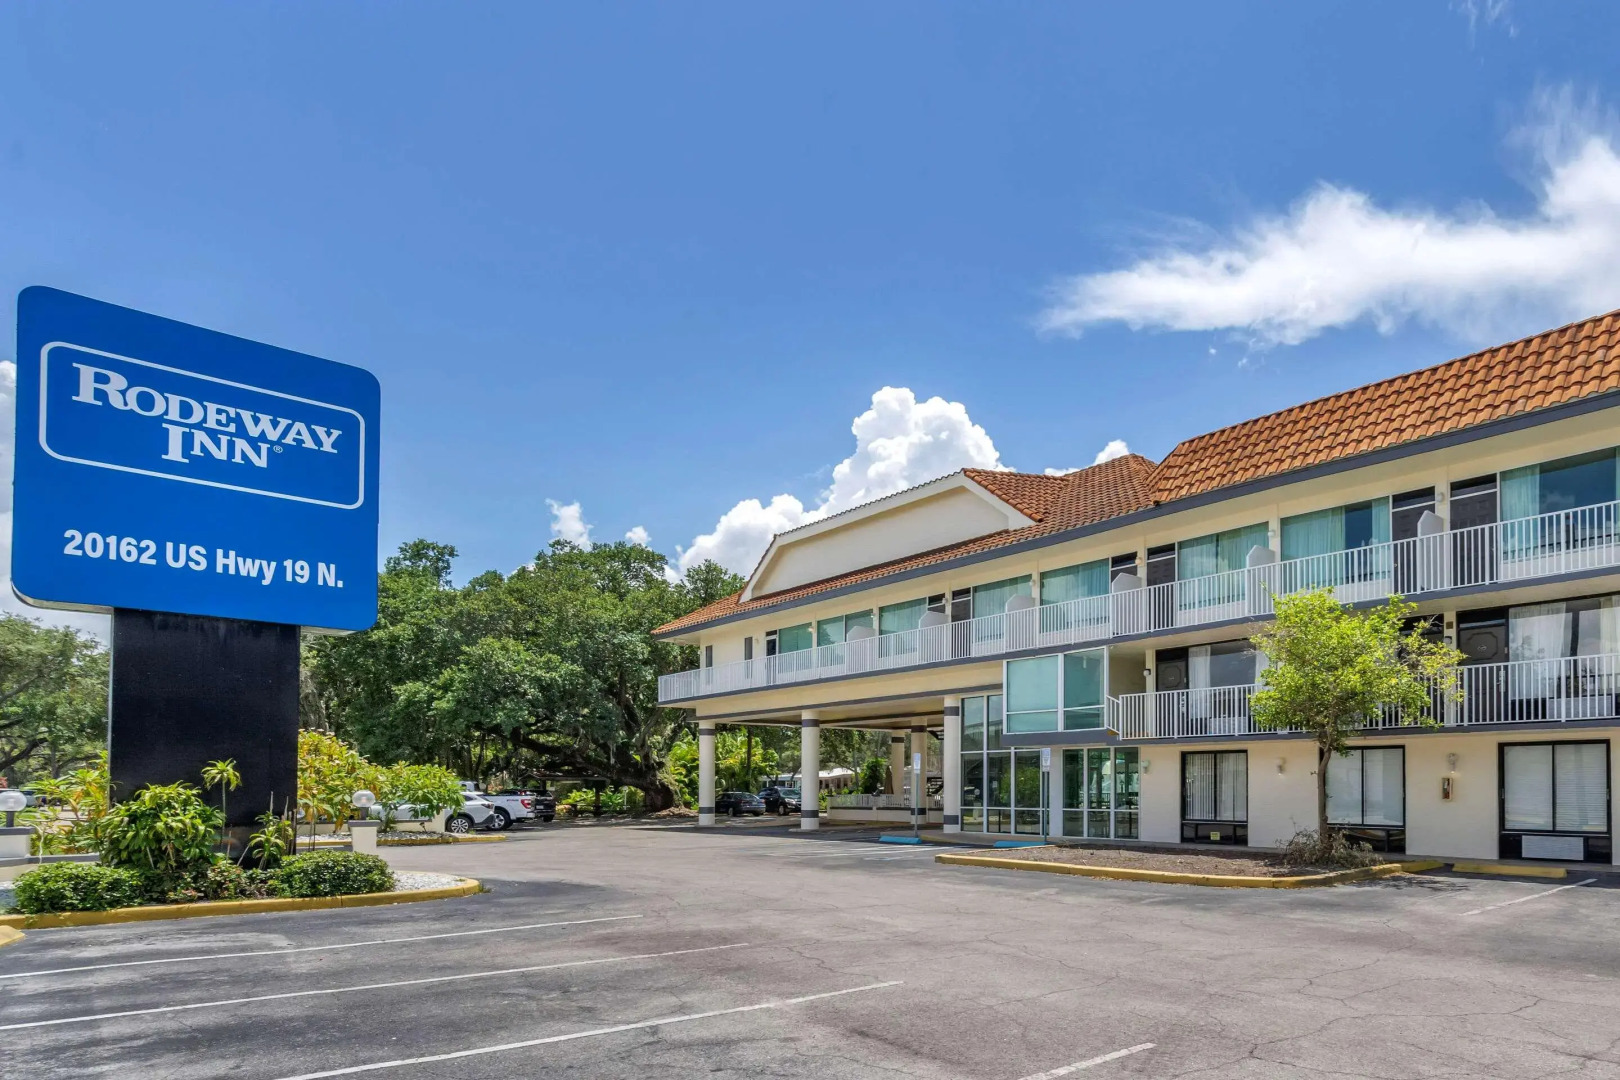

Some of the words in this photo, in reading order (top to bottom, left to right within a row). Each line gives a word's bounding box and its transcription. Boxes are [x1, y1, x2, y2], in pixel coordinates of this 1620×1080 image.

[72, 362, 342, 454] RODEWAY
[63, 529, 157, 565] 20162
[165, 541, 208, 571] US
[216, 549, 277, 585] Hwy
[283, 559, 310, 584] 19
[317, 562, 344, 588] N.
